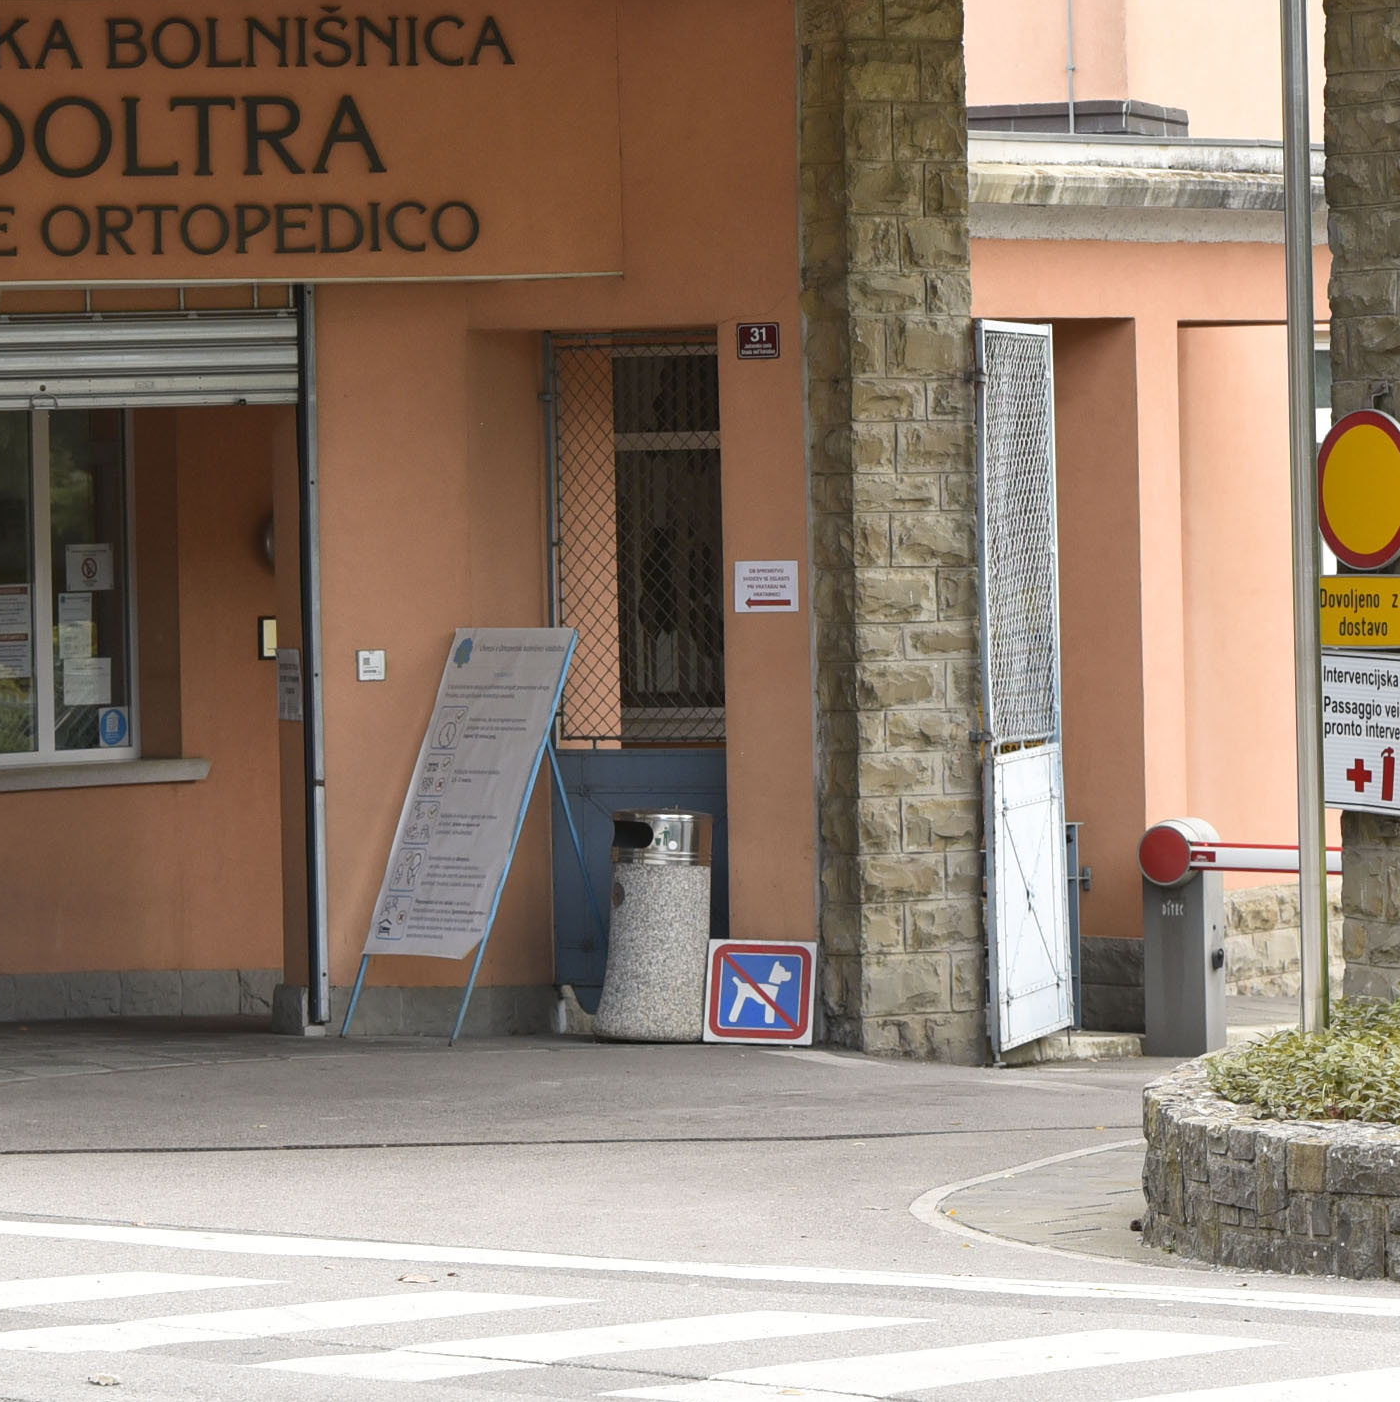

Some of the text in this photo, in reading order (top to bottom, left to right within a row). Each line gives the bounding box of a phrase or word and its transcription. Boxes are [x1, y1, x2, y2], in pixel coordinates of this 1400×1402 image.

[105, 6, 515, 70] BOLNIŠNICA
[40, 201, 480, 258] ORTOPEDICO
[750, 327, 766, 342] 31
[1320, 588, 1380, 613] Dovoljeno
[1339, 617, 1388, 637] dostavo
[1323, 665, 1399, 691] Intervencijska
[1324, 695, 1382, 720] Passaggio
[1324, 721, 1362, 739] pronto
